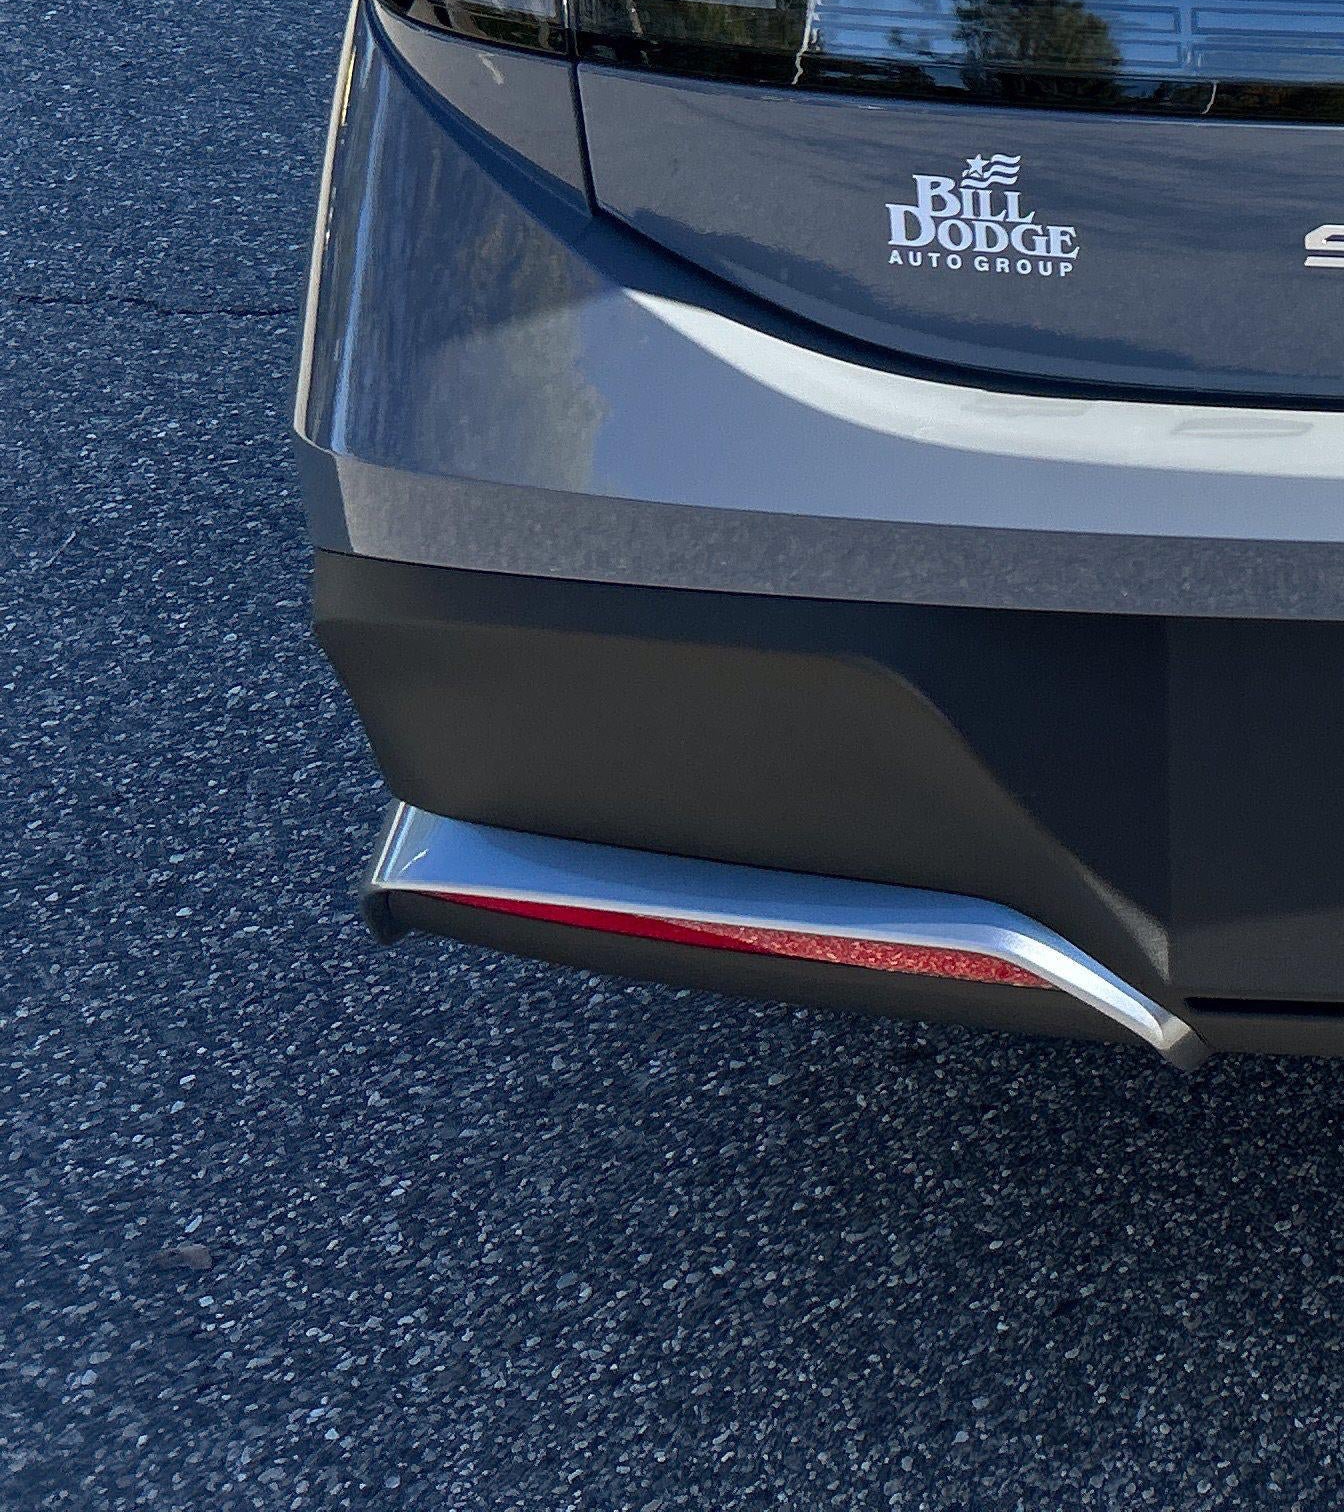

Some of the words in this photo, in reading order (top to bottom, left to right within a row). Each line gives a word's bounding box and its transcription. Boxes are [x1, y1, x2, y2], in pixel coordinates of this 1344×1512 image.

[912, 174, 1035, 223] BILL
[885, 203, 1080, 259] DODGE
[888, 250, 962, 270] AUTO
[974, 256, 1074, 277] GROUP
